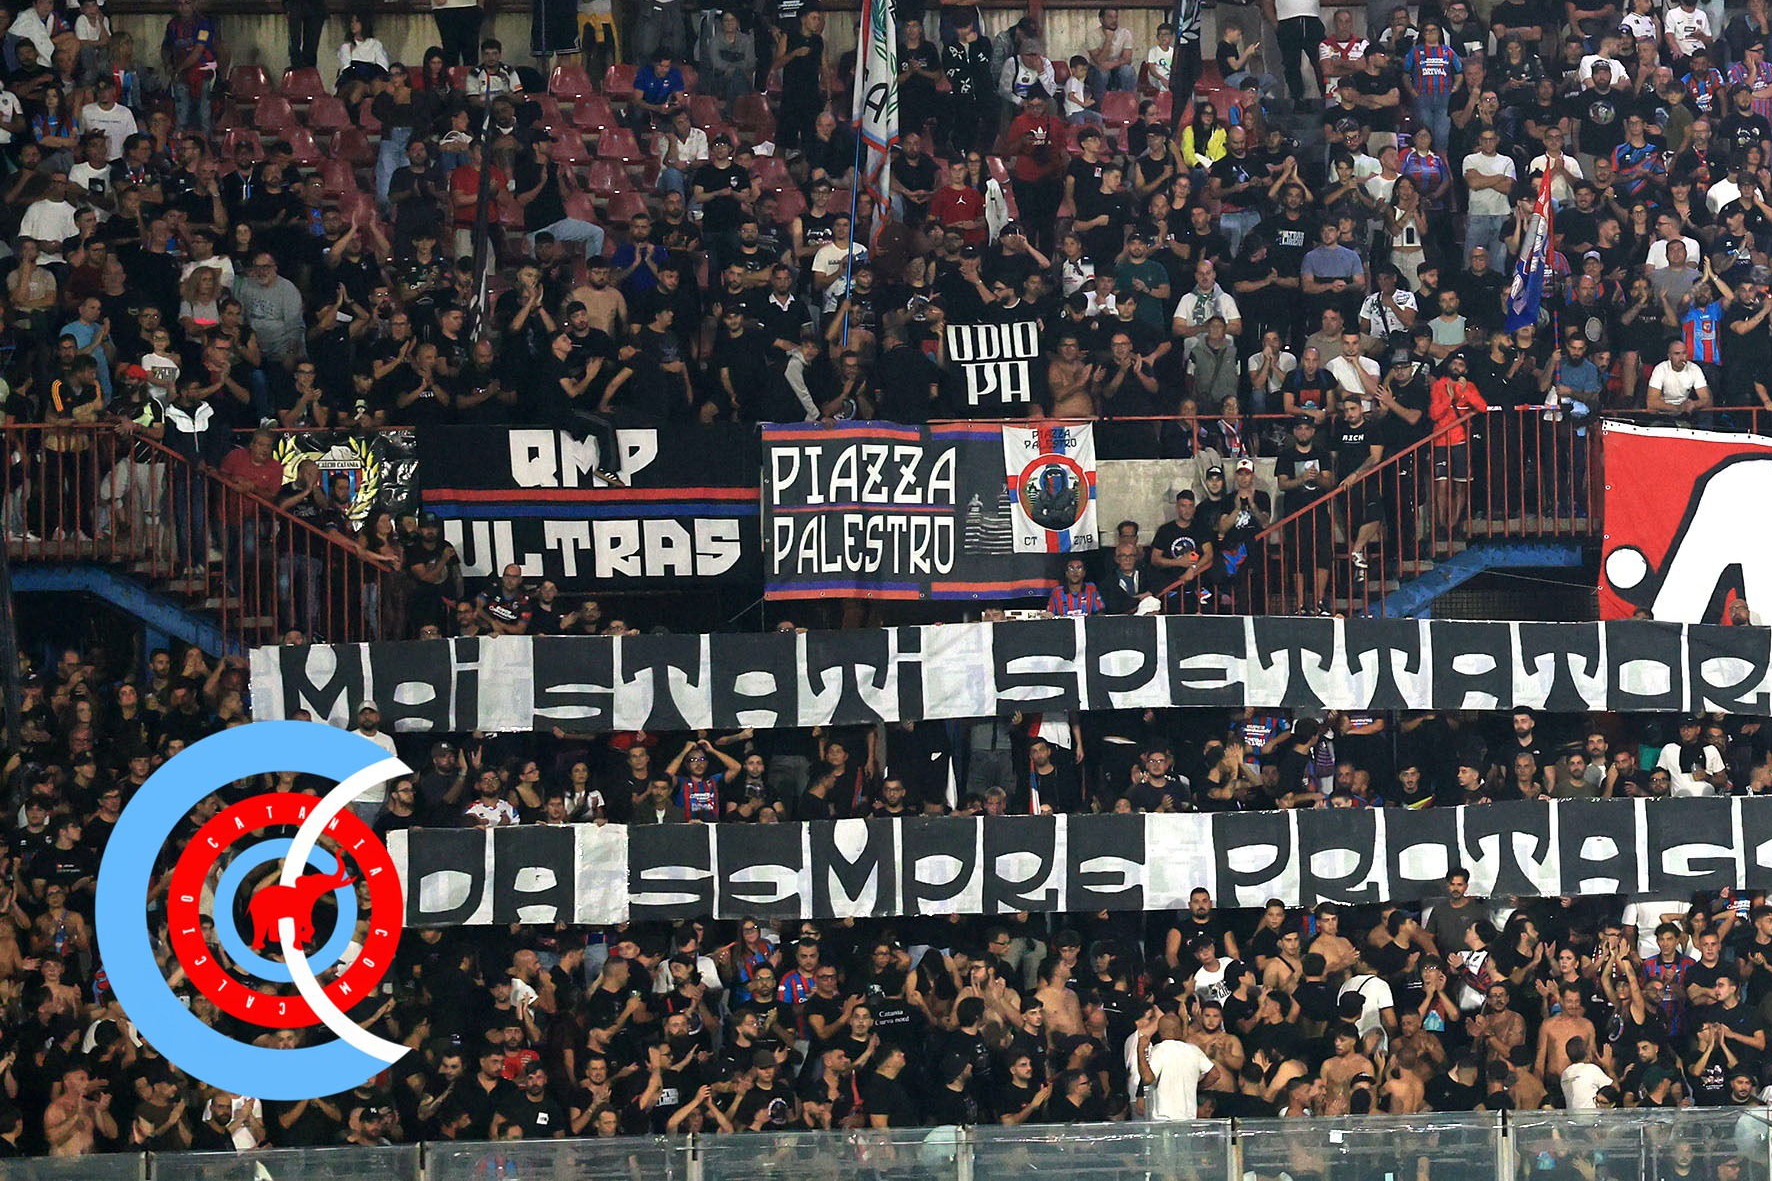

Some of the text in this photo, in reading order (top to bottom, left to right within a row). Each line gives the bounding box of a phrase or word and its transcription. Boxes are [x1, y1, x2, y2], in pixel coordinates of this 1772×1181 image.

[961, 362, 1032, 406] PA
[771, 444, 956, 506] PIAZZA
[444, 519, 741, 577] ULTRAS
[773, 513, 955, 574] PALESTRO
